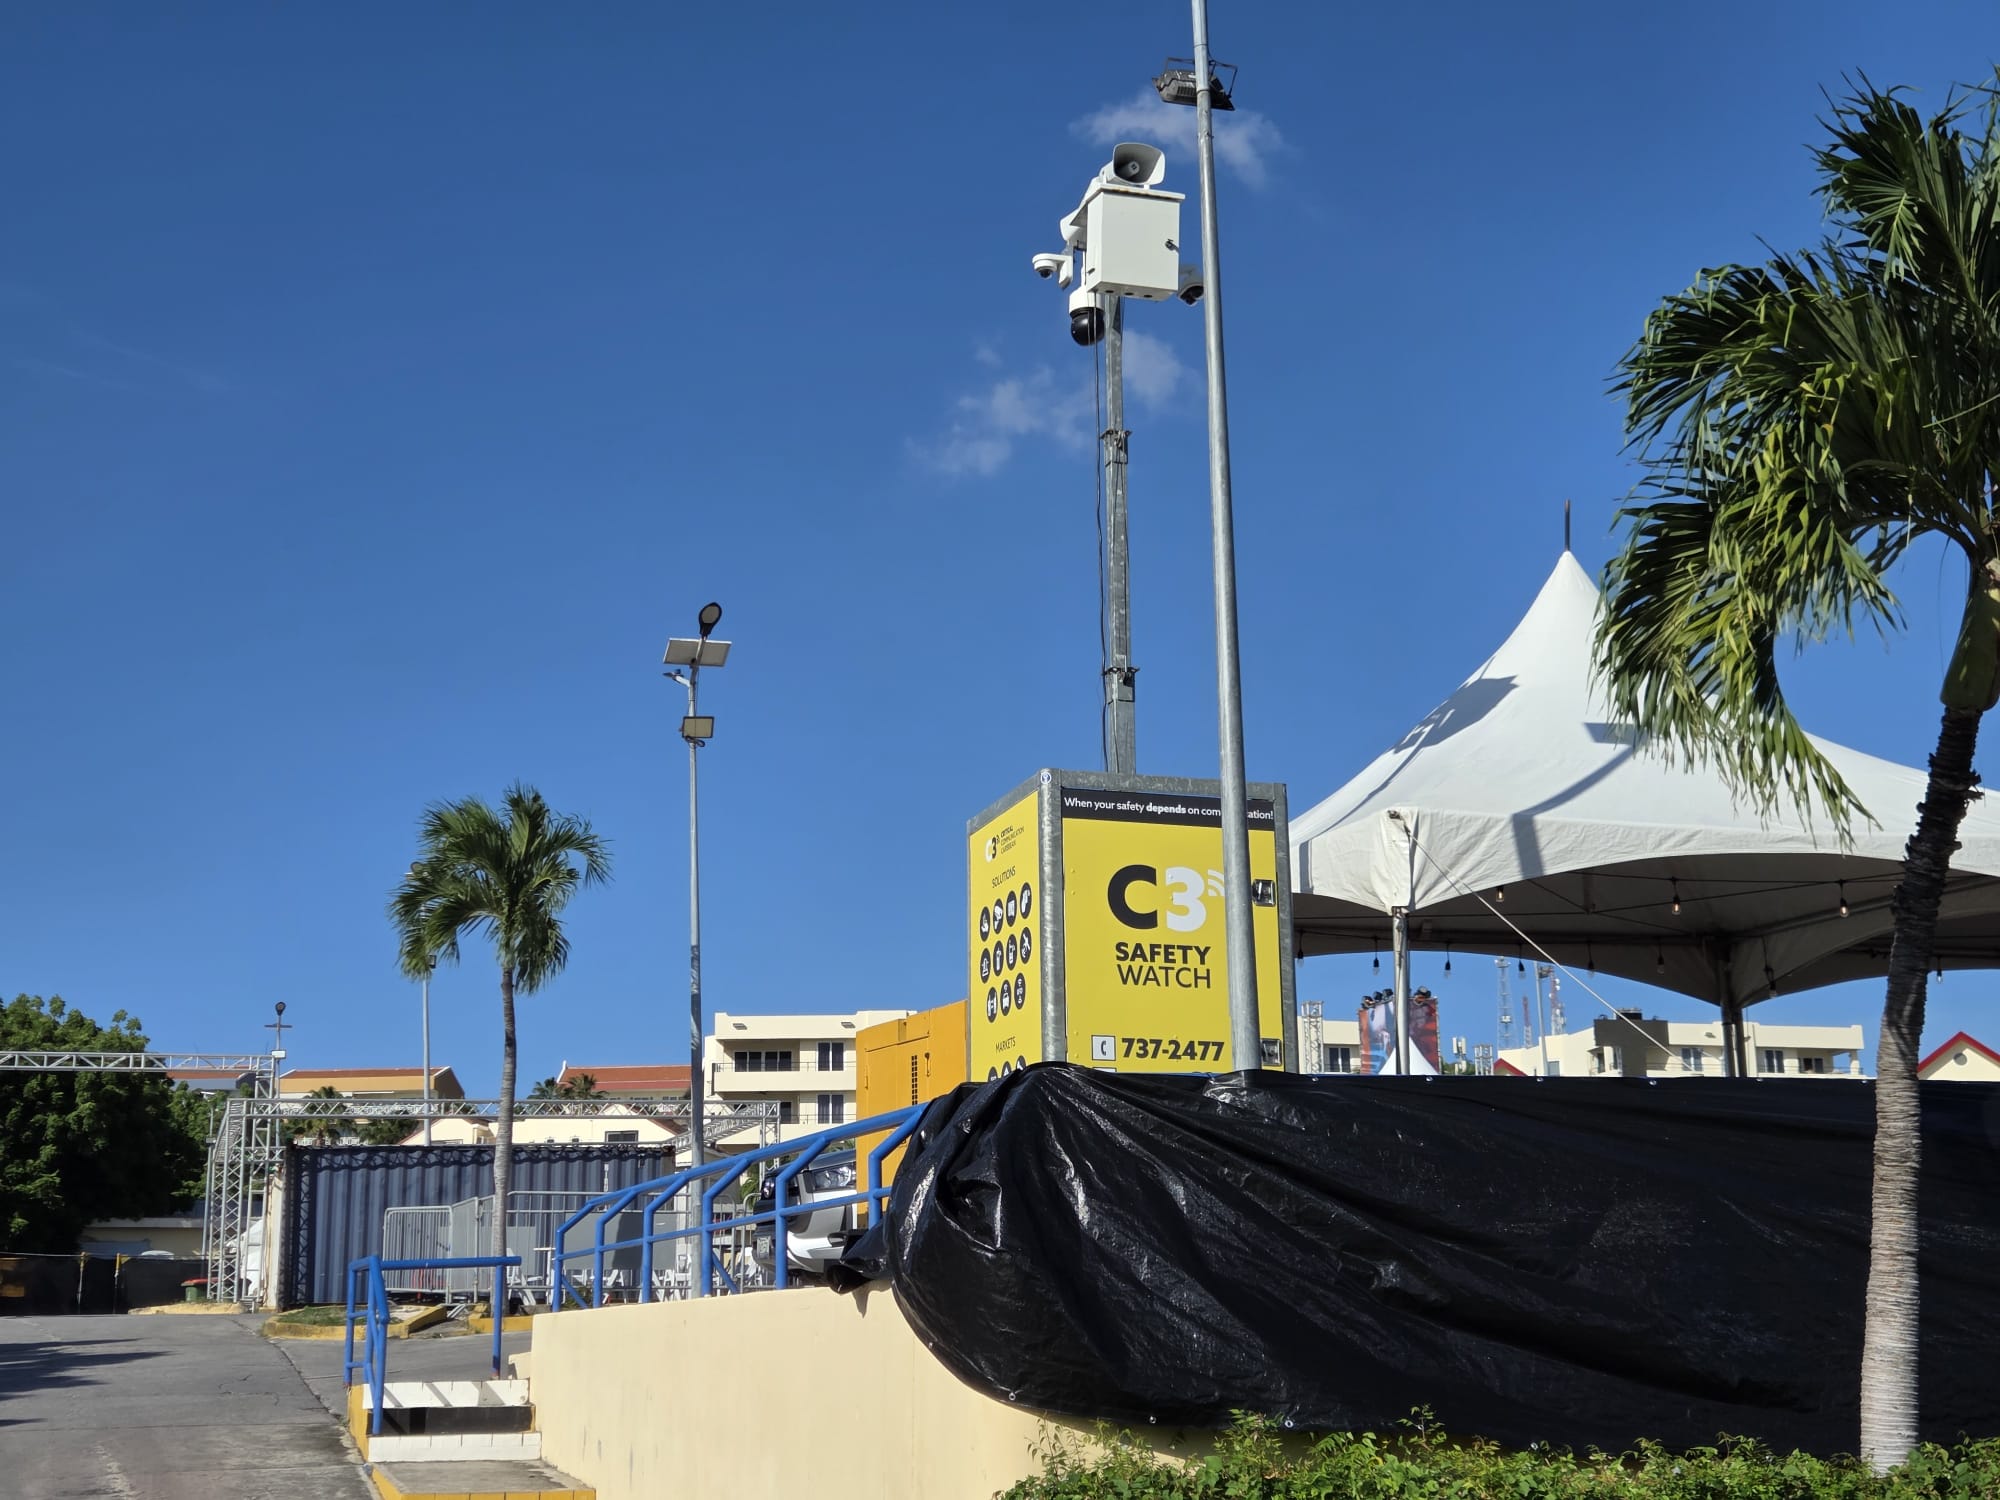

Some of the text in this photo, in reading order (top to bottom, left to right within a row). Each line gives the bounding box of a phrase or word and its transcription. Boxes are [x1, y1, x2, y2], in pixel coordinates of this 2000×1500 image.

[1064, 797, 1274, 820] When your safety depends on comation!
[985, 837, 996, 863] C3
[992, 866, 1015, 888] SOLUTIONS
[1107, 864, 1207, 932] C3
[1115, 941, 1211, 965] SAFETY
[1117, 964, 1211, 989] WATCH
[996, 1036, 1015, 1054] MARKETS
[1121, 1037, 1225, 1062] 737-2477
